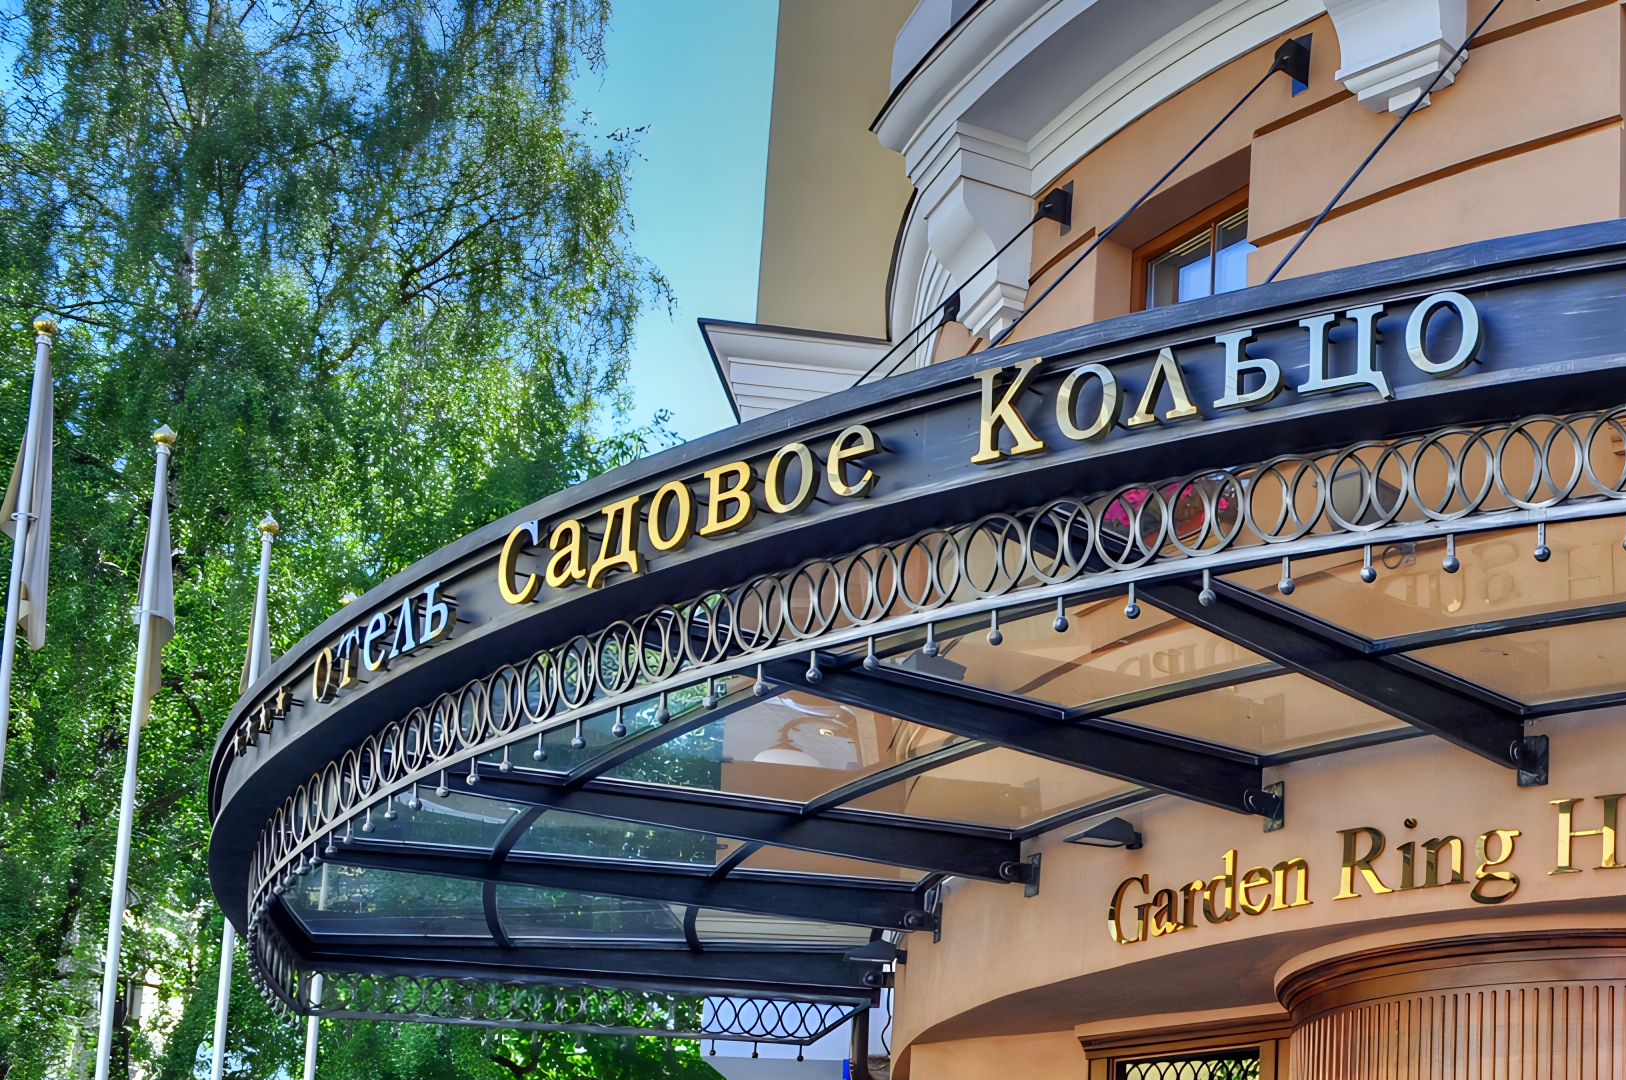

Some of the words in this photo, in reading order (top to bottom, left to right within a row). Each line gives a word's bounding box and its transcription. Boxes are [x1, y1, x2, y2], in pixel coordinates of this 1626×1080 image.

[499, 424, 882, 604] Садовое
[971, 292, 1484, 464] Кольцо
[1107, 849, 1314, 945] Garden
[1332, 817, 1521, 904] Ring
